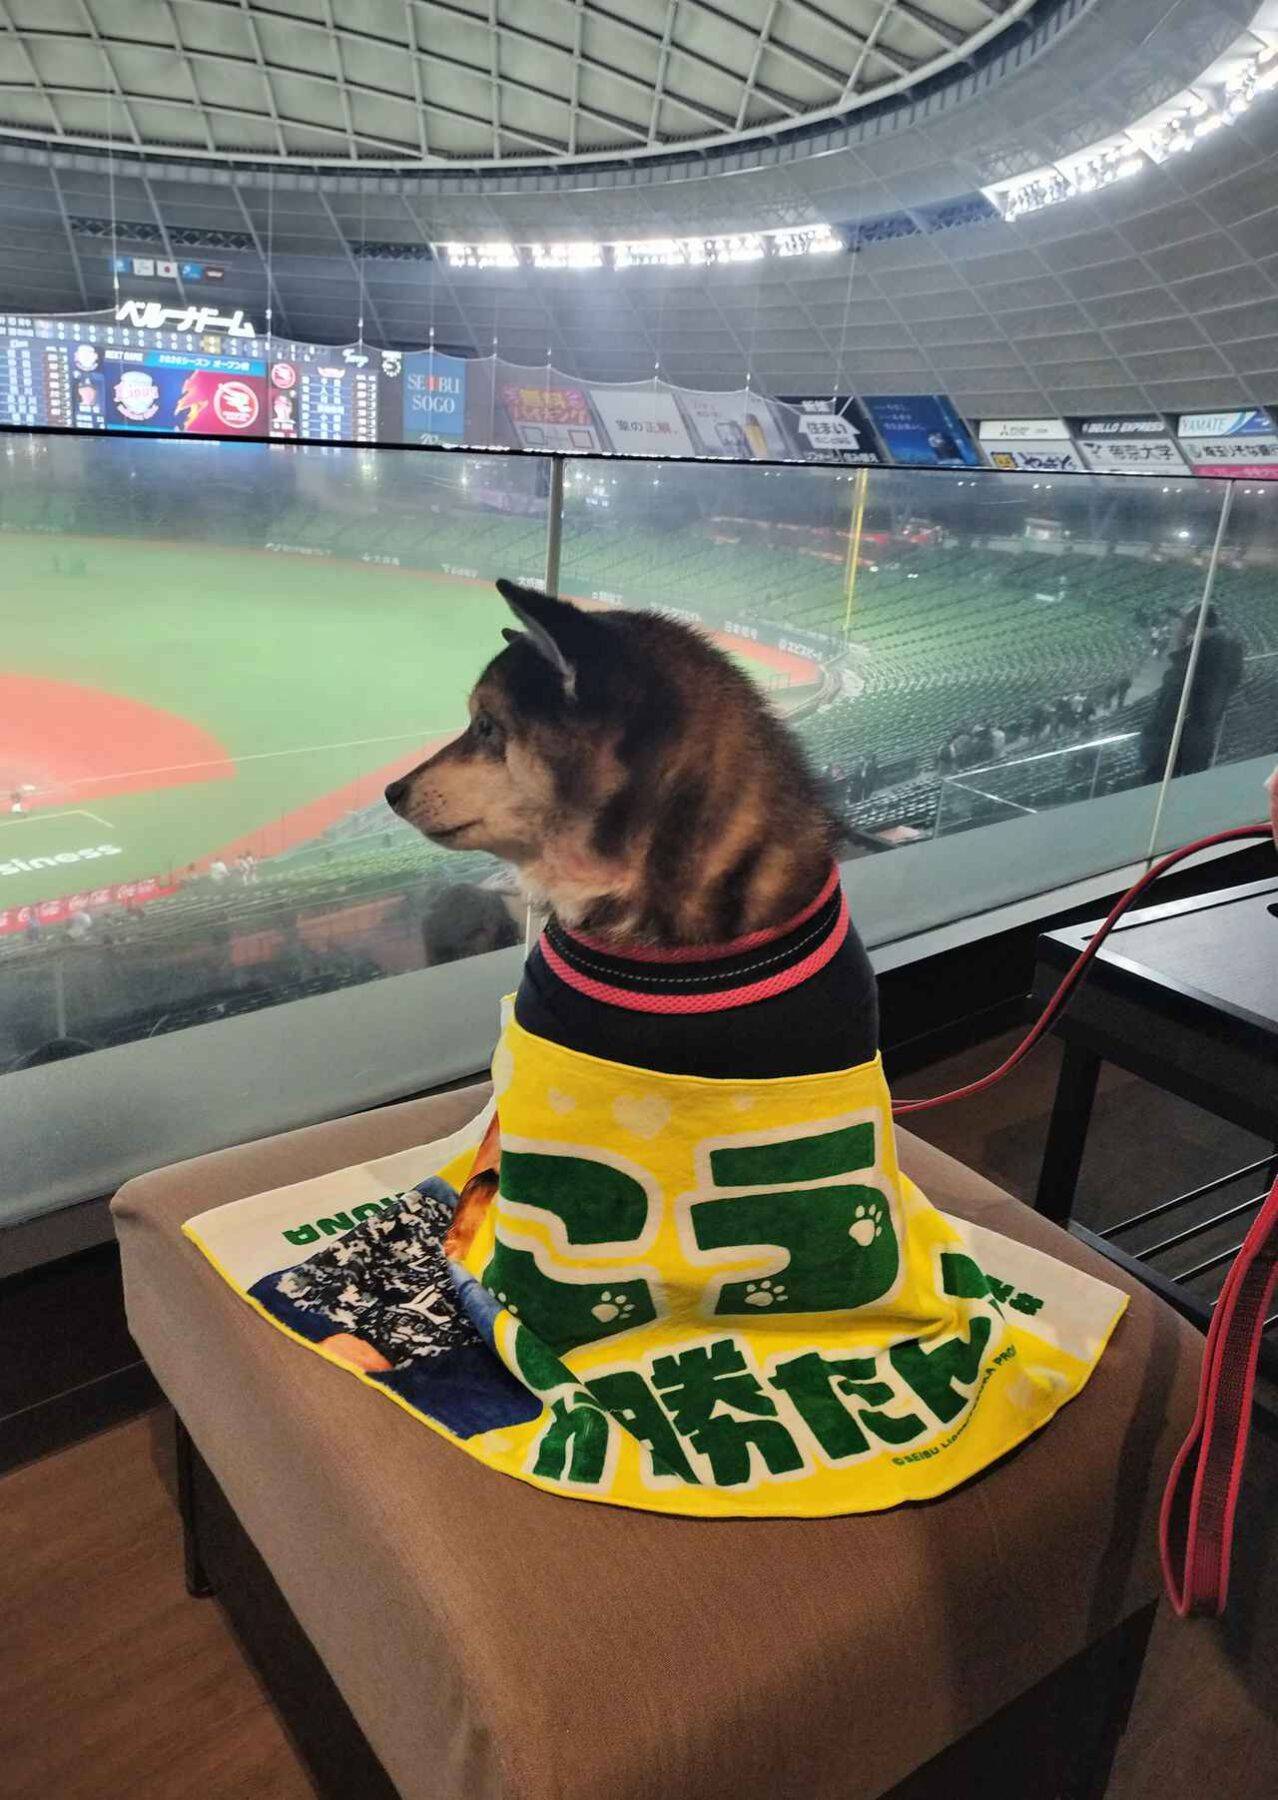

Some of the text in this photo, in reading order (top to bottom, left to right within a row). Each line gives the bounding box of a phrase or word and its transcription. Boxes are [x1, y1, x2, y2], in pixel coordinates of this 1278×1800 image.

[115, 300, 255, 338] ベルーナドーム
[407, 374, 461, 395] SEIBU
[412, 397, 456, 414] SOGO
